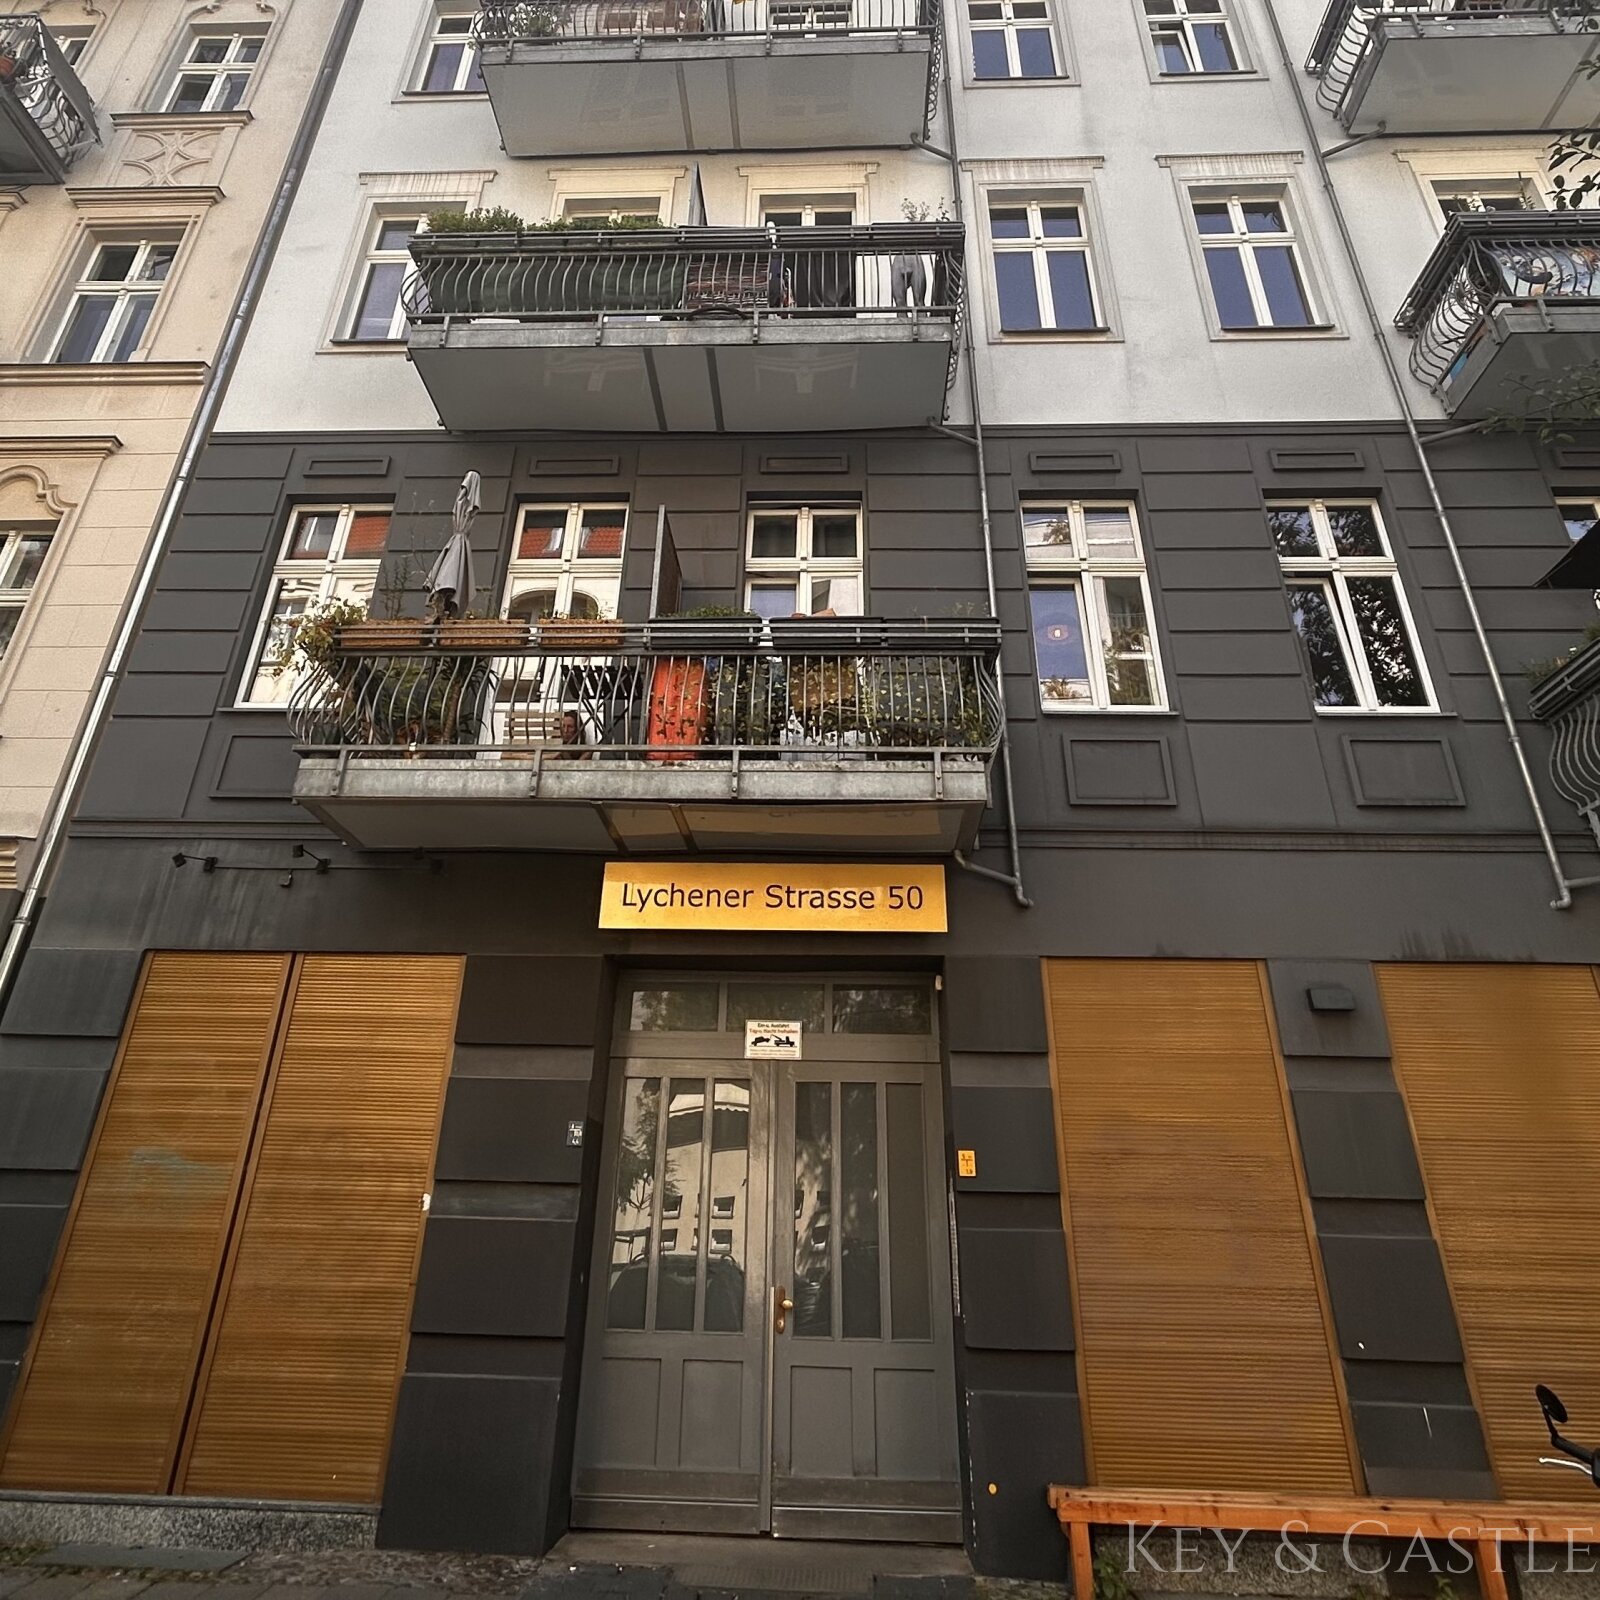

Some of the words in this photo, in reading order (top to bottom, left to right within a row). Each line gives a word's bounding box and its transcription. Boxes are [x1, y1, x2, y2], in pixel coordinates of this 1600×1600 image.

[621, 882, 754, 912] Lychener
[764, 884, 876, 909] Strasse
[888, 885, 923, 909] 50
